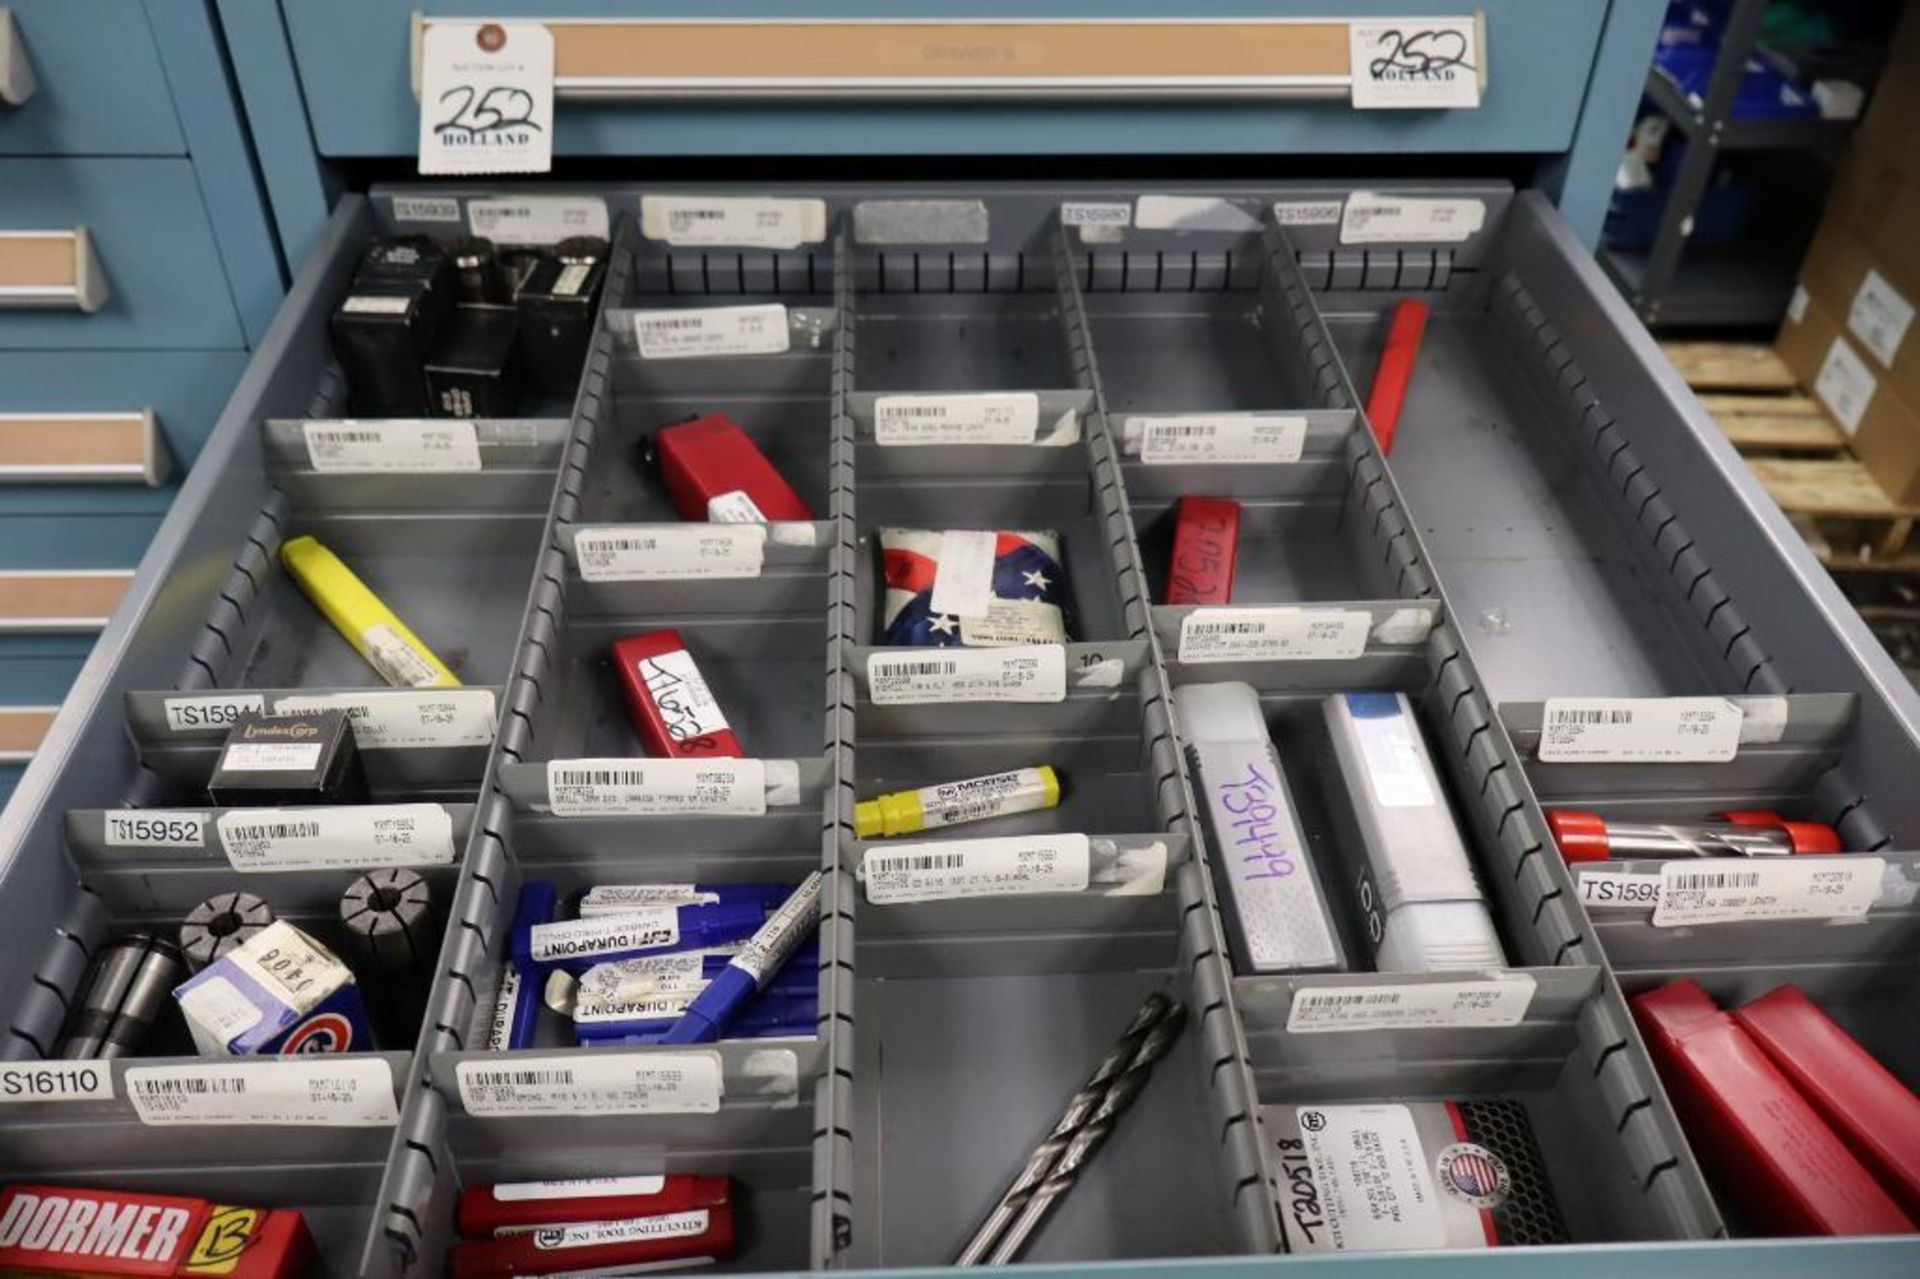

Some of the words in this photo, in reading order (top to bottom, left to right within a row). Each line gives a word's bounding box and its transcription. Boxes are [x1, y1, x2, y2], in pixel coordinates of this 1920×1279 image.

[1370, 30, 1476, 80] 252
[434, 86, 541, 134] 252
[443, 132, 529, 146] HOLLAND
[111, 818, 199, 842] TS15952
[1220, 763, 1296, 882] T39449
[1583, 880, 1661, 902] TS1599
[542, 935, 628, 957] DURAPOINT
[582, 1001, 668, 1016] DURAPOINT
[0, 1069, 99, 1095] S16110
[1277, 1138, 1324, 1245] T20518
[0, 1194, 190, 1262] DORMER
